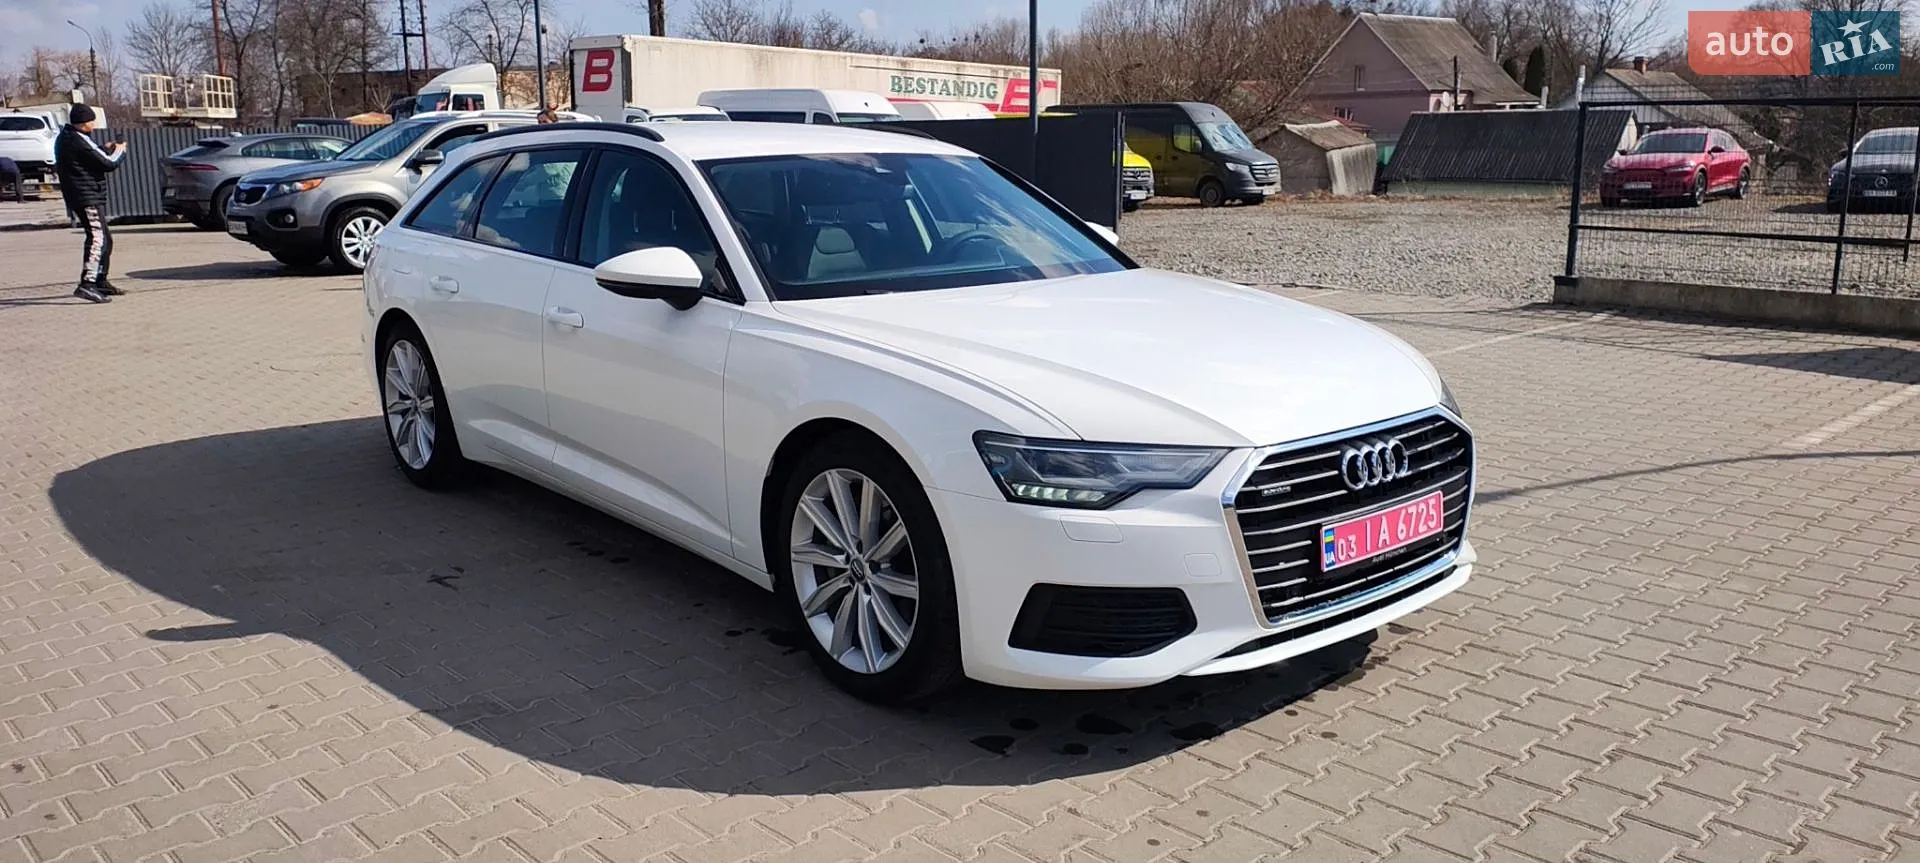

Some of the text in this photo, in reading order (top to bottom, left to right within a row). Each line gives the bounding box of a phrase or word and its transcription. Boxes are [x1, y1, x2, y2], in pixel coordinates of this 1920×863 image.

[583, 49, 615, 92] B
[1338, 534, 1357, 560] 03
[1397, 499, 1438, 541] 6725
[1325, 552, 1336, 564] UA
